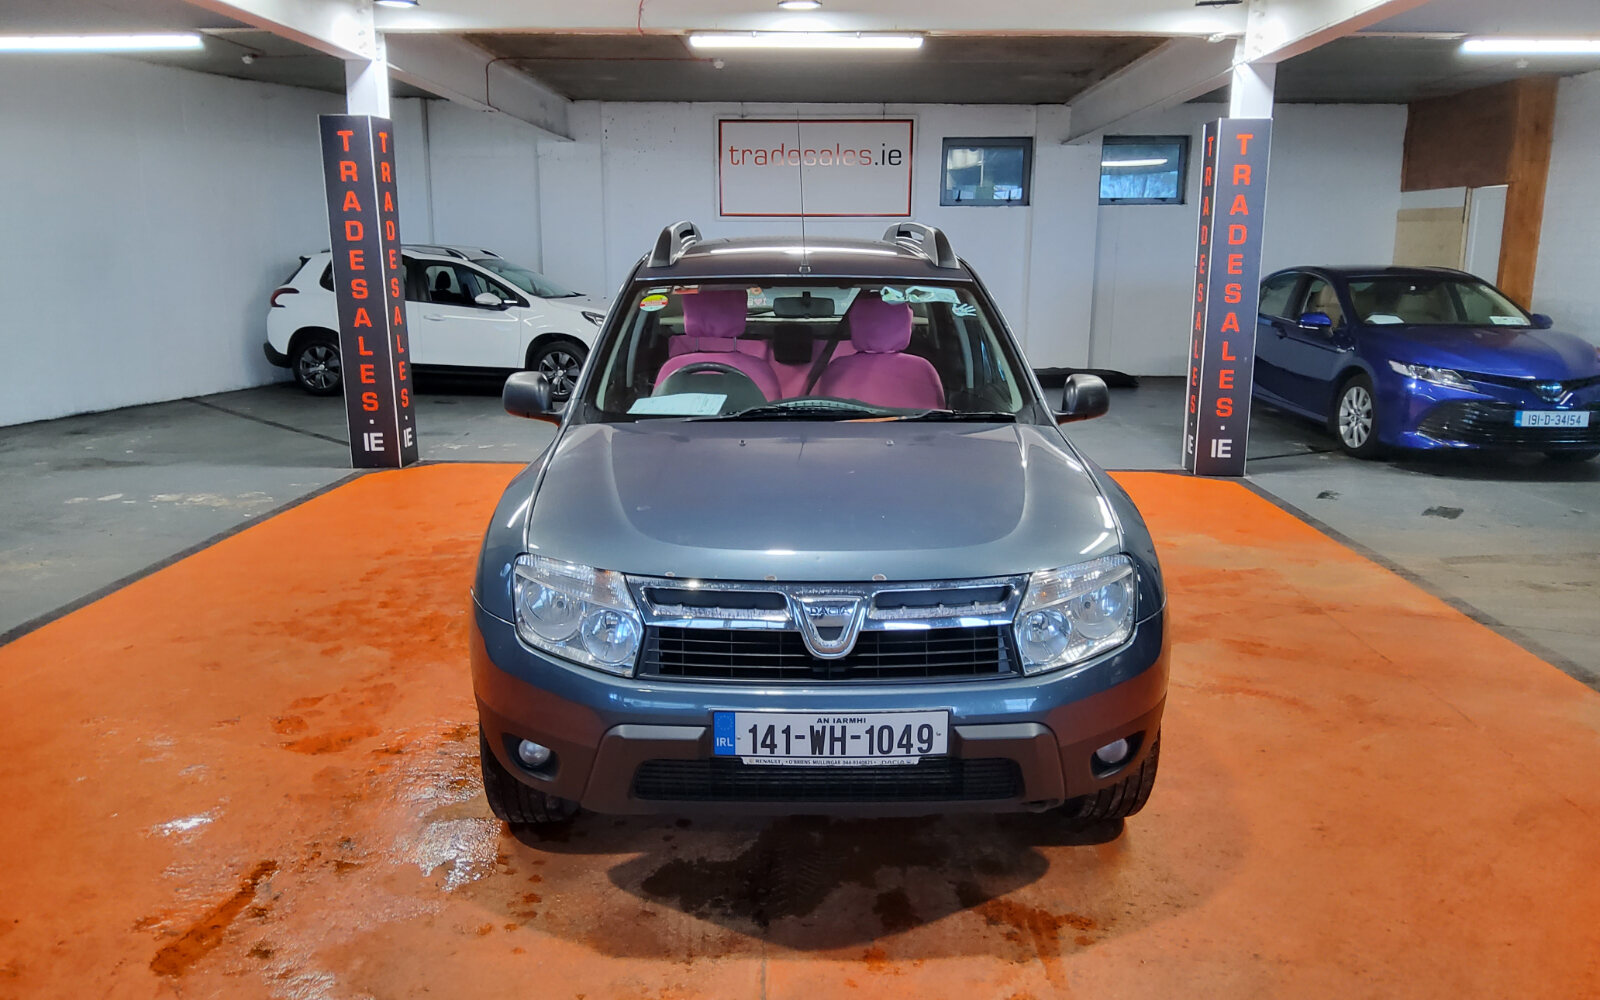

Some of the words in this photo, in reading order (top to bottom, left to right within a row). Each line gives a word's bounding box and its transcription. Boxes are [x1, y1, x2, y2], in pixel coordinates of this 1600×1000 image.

[728, 143, 902, 166] tradesales.ie
[1528, 414, 1582, 425] 191-D-34154
[809, 606, 850, 616] DACIA
[716, 737, 734, 747] IRL
[748, 723, 934, 756] 141-WH-1049
